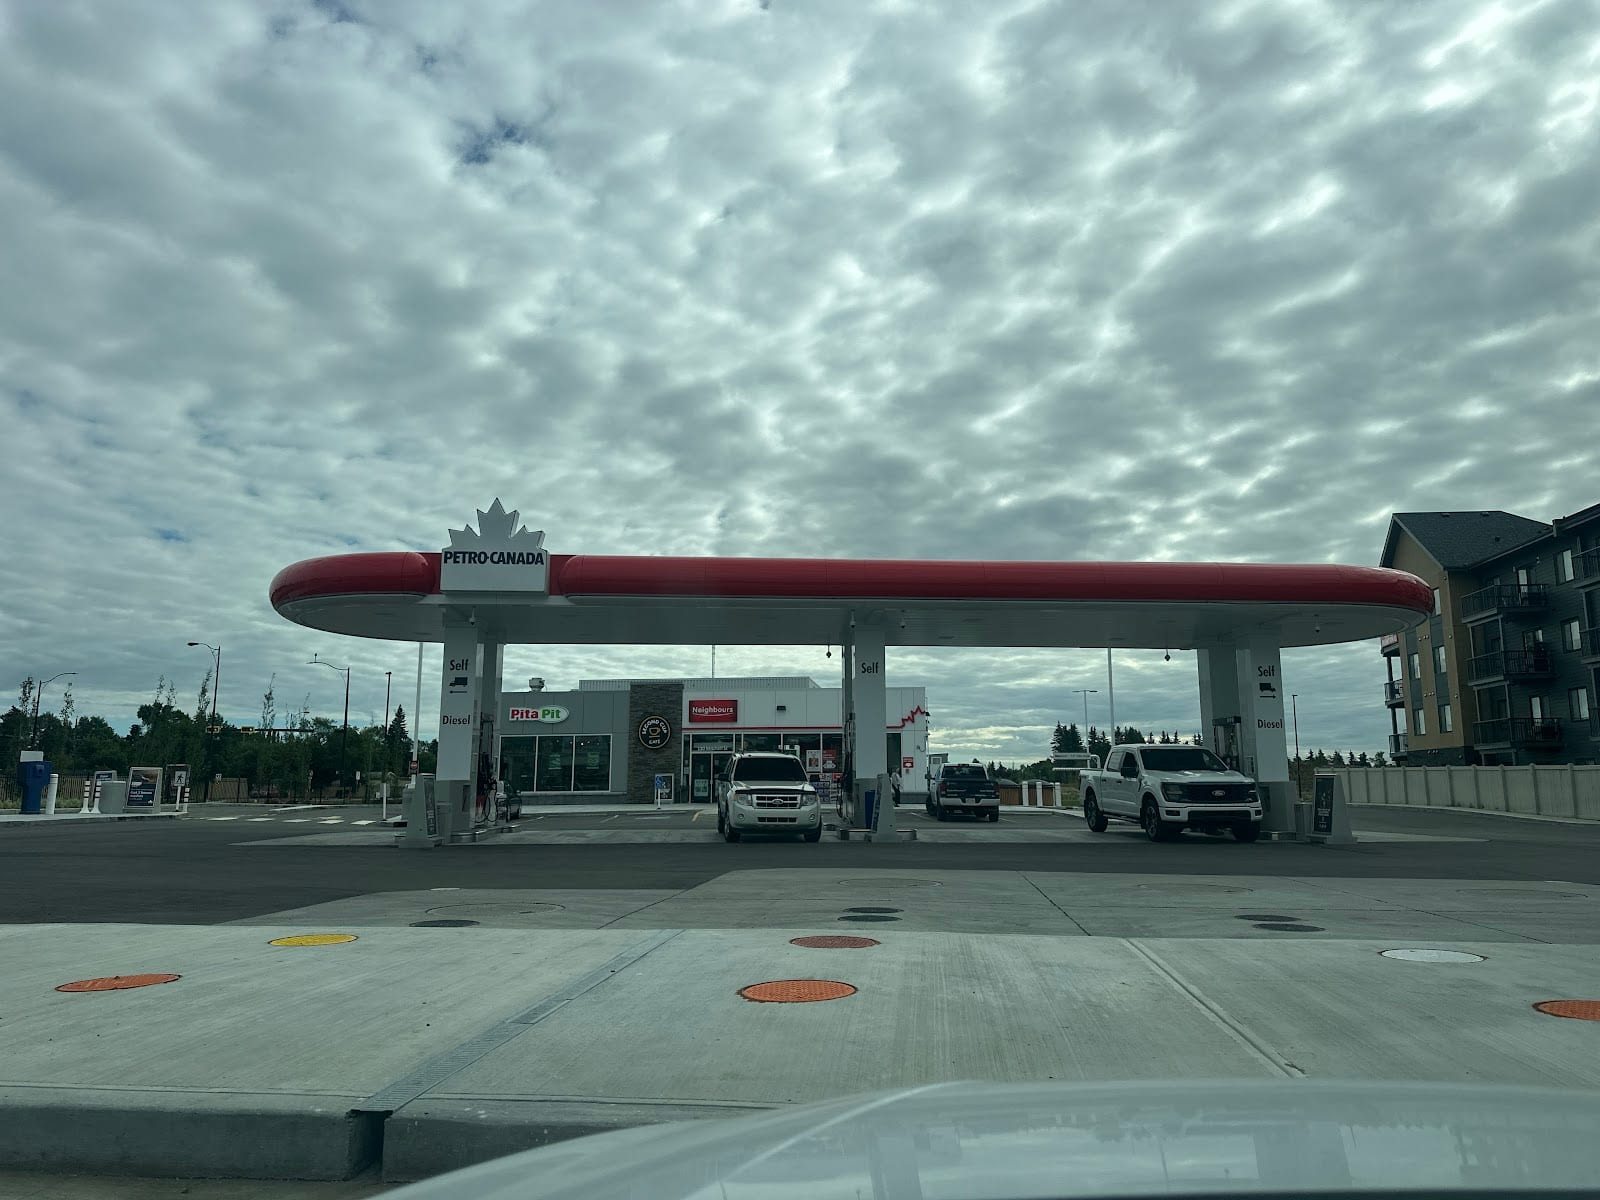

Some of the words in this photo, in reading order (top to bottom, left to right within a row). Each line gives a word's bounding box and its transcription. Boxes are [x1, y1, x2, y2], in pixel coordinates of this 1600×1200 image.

[449, 659, 469, 671] Self
[861, 662, 879, 674] Self
[1257, 665, 1275, 677] Self
[511, 709, 538, 719] Pita
[541, 709, 561, 719] Pit
[692, 706, 734, 714] Neighbours
[442, 714, 471, 725] Diesel
[1257, 719, 1283, 729] Diesel
